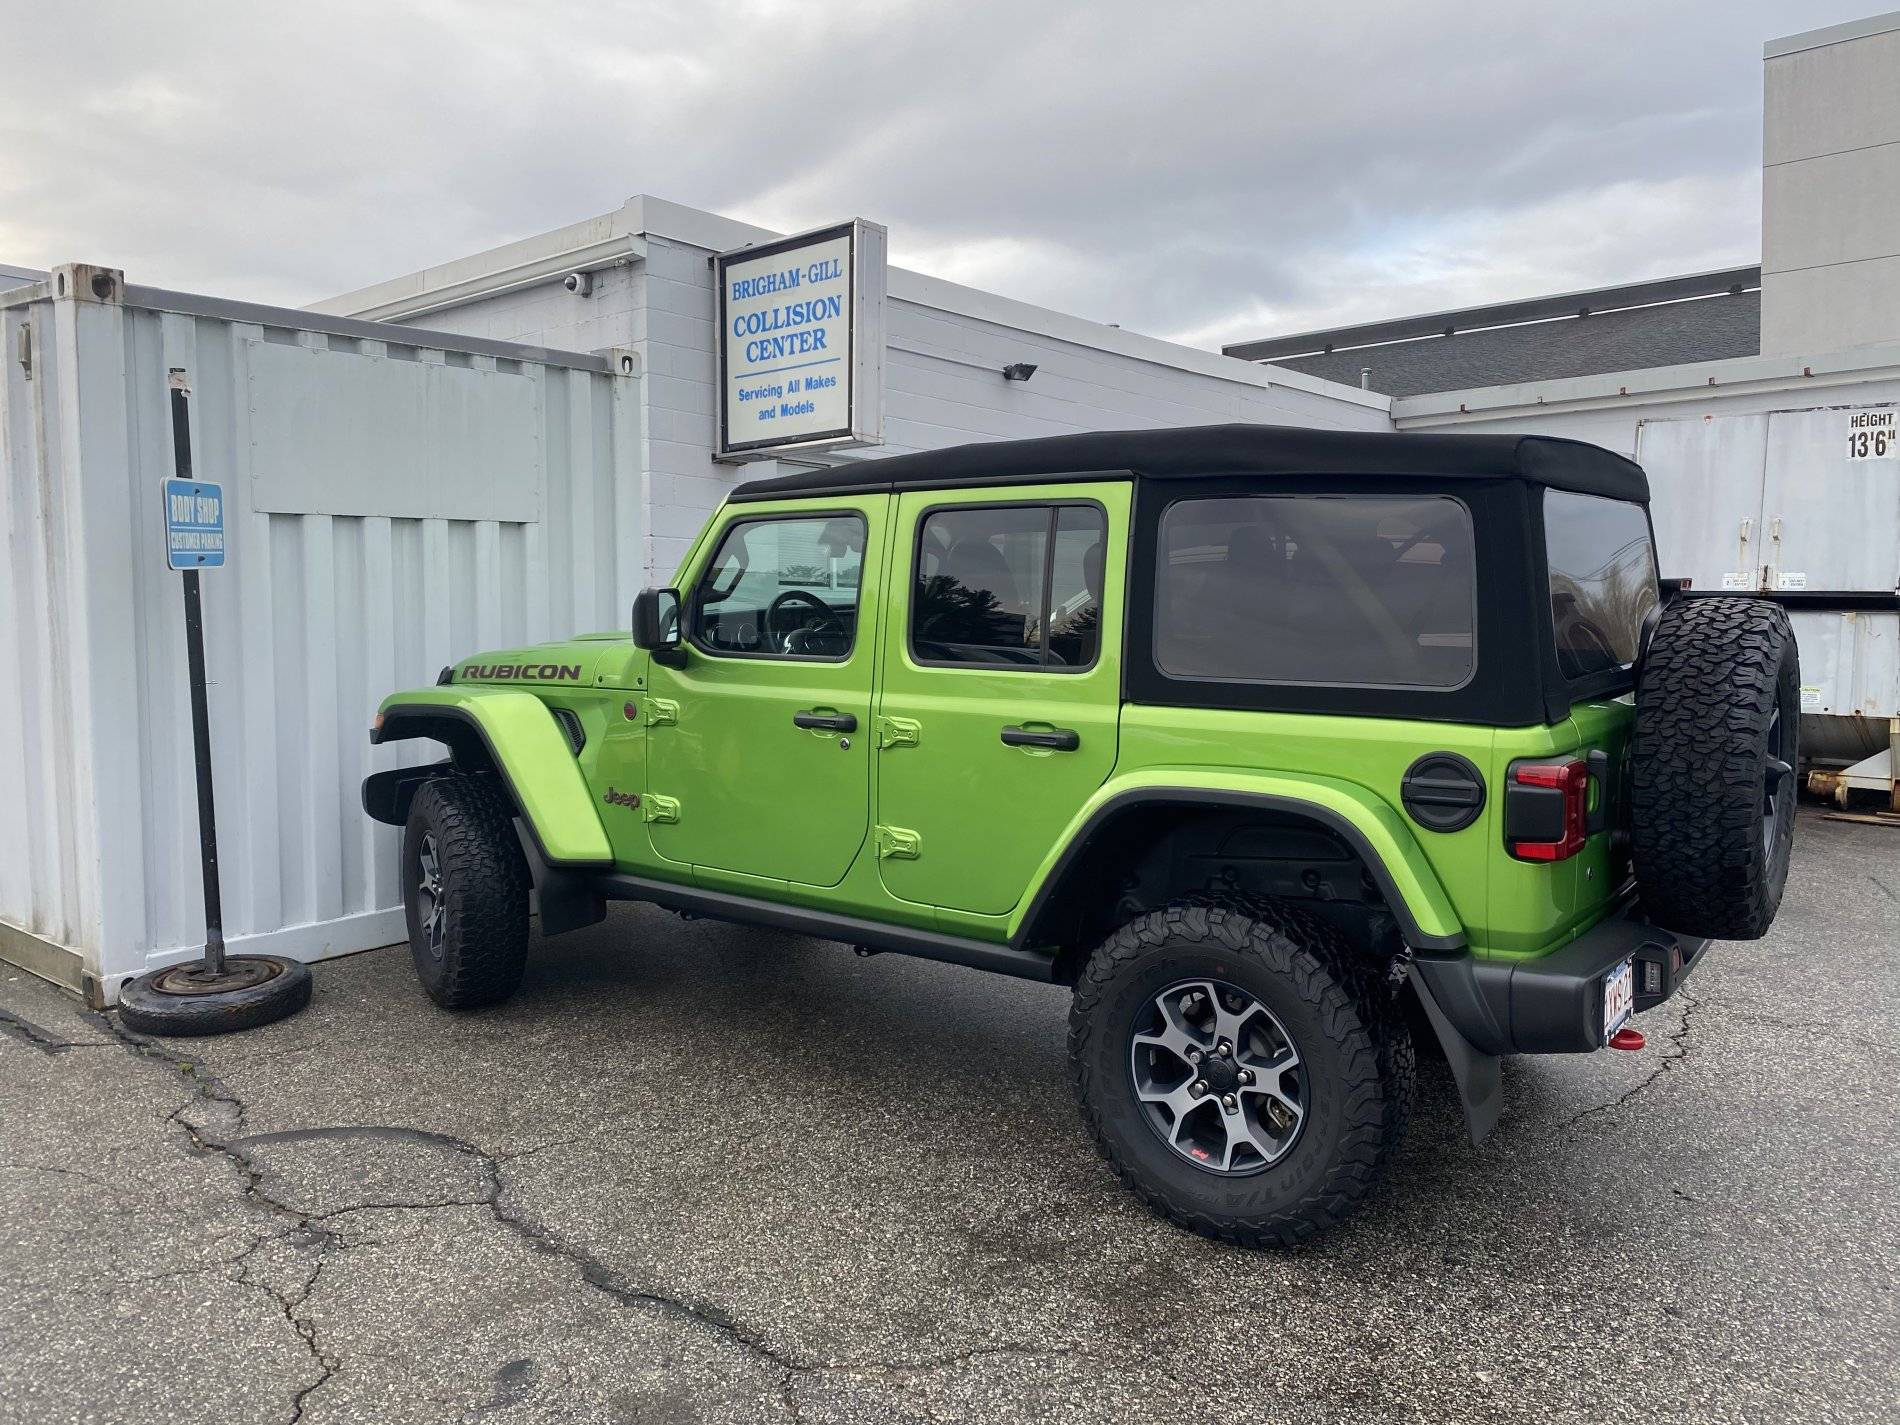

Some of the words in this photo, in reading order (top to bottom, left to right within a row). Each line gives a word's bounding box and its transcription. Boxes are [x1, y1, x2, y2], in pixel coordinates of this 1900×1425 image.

[732, 258, 842, 301] BRIGHAM-GILL
[733, 295, 842, 338] COLLISION
[746, 328, 827, 363] CENTER
[738, 384, 782, 402] Servicing
[787, 379, 800, 394] All
[805, 375, 837, 391] Makes
[758, 405, 776, 421] and
[781, 399, 815, 417] Models
[1851, 413, 1894, 428] HEIGHT
[1848, 429, 1896, 458] 13'6"
[171, 495, 195, 522] BODY
[197, 497, 219, 524] SHOP
[461, 665, 582, 681] RUBICON
[603, 786, 641, 811] Jeep
